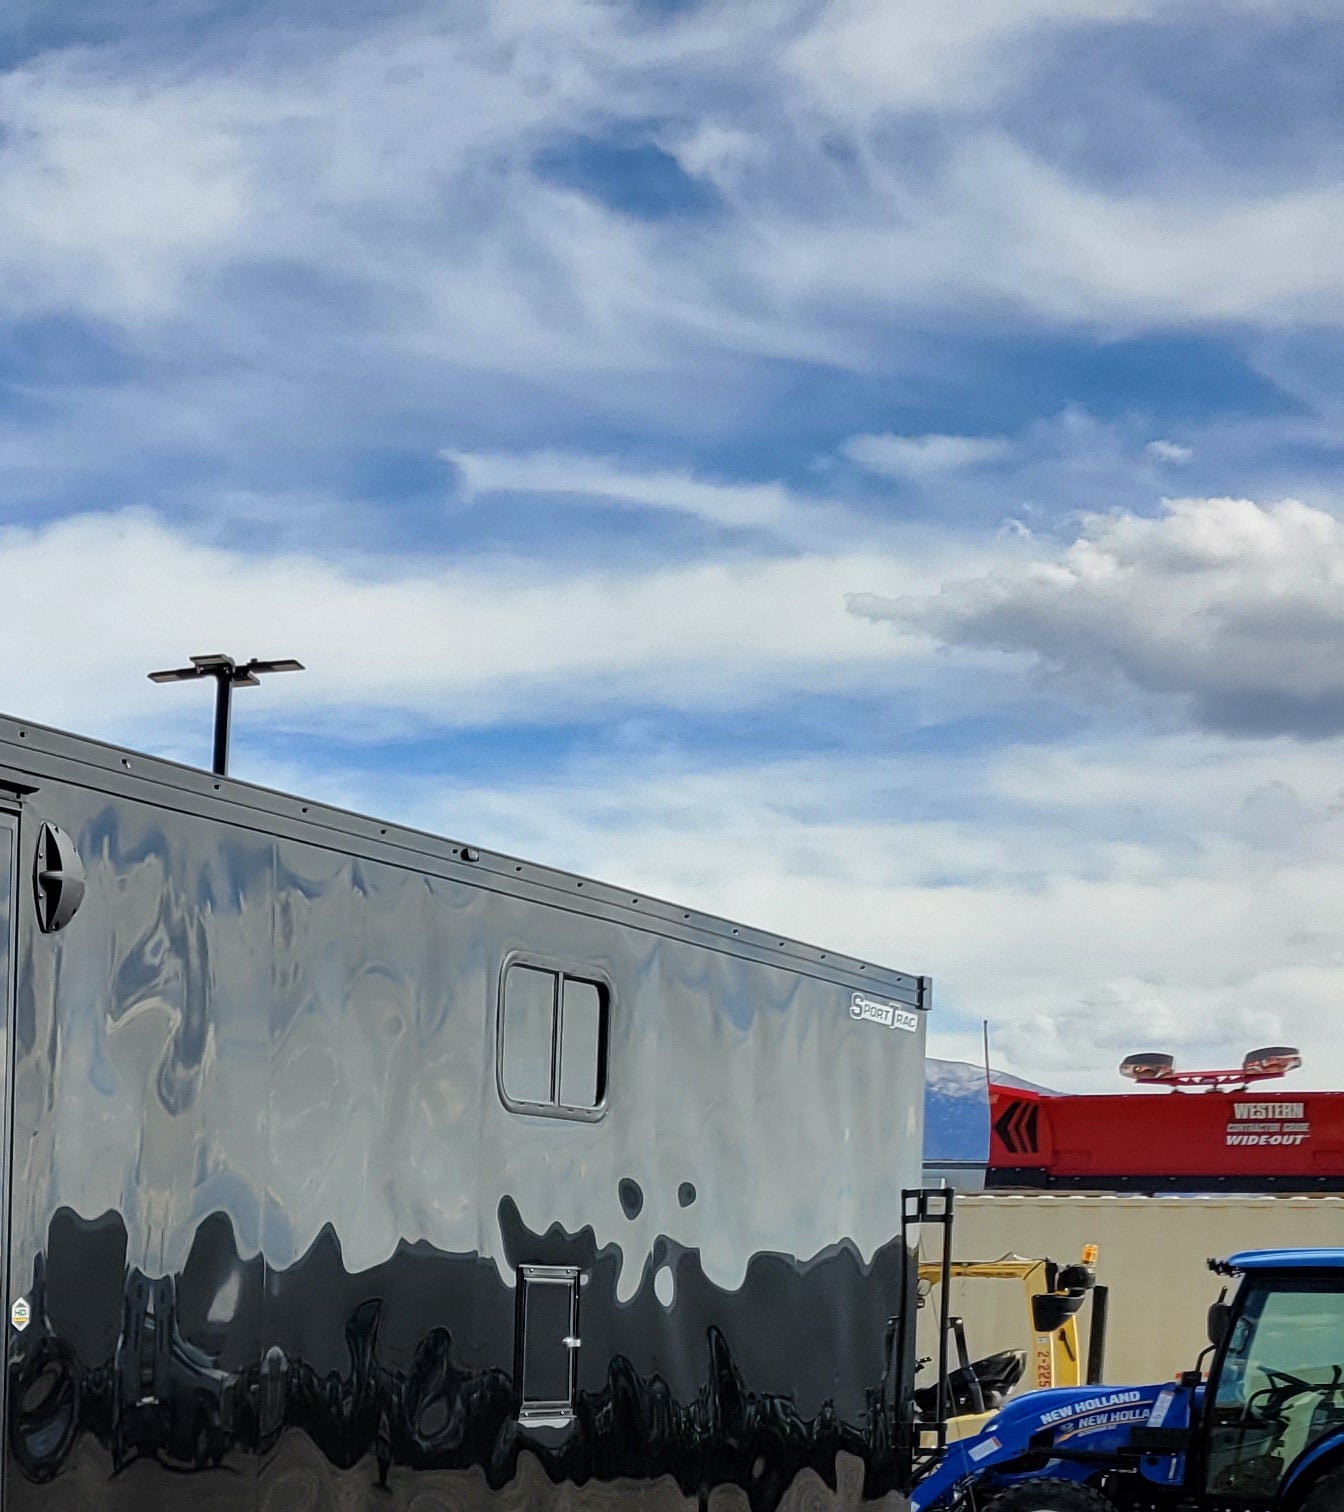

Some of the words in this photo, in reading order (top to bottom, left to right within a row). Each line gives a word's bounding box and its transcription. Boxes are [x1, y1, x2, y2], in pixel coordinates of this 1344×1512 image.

[1234, 1103, 1304, 1119] WESTERN
[1040, 1406, 1073, 1425] NEW
[1075, 1391, 1141, 1413] HOLLAND
[1078, 1413, 1109, 1429] NEW
